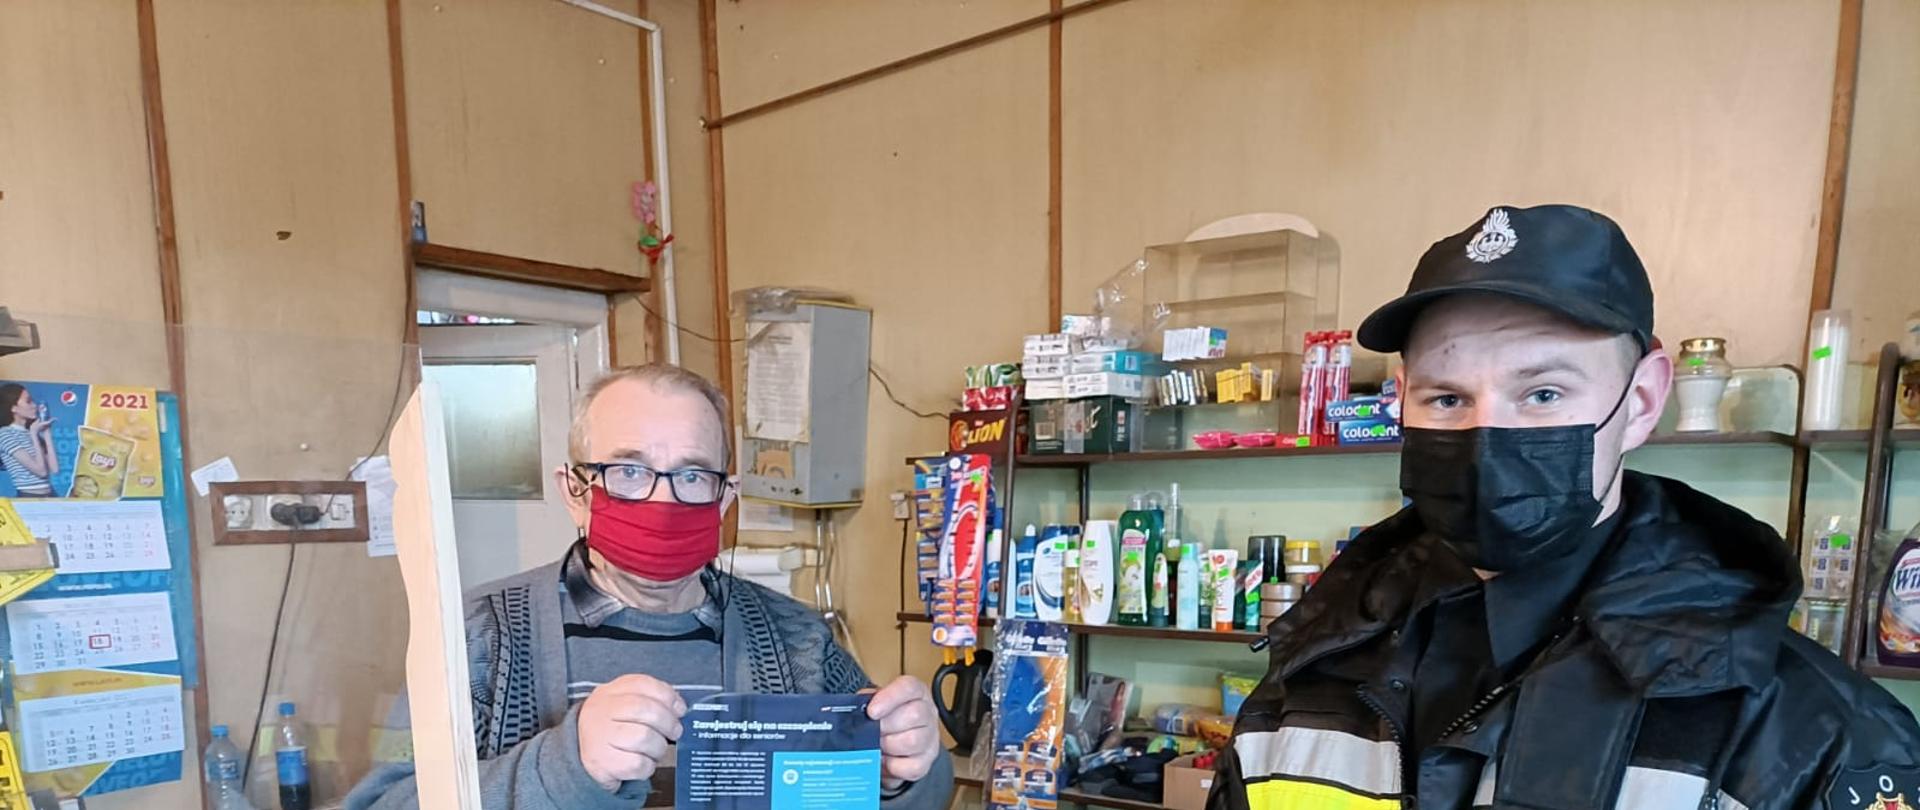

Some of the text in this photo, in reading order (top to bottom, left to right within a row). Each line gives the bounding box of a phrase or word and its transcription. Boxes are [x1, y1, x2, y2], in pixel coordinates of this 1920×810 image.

[100, 393, 149, 409] 2021
[1328, 402, 1380, 417] colont
[967, 417, 1006, 444] LION
